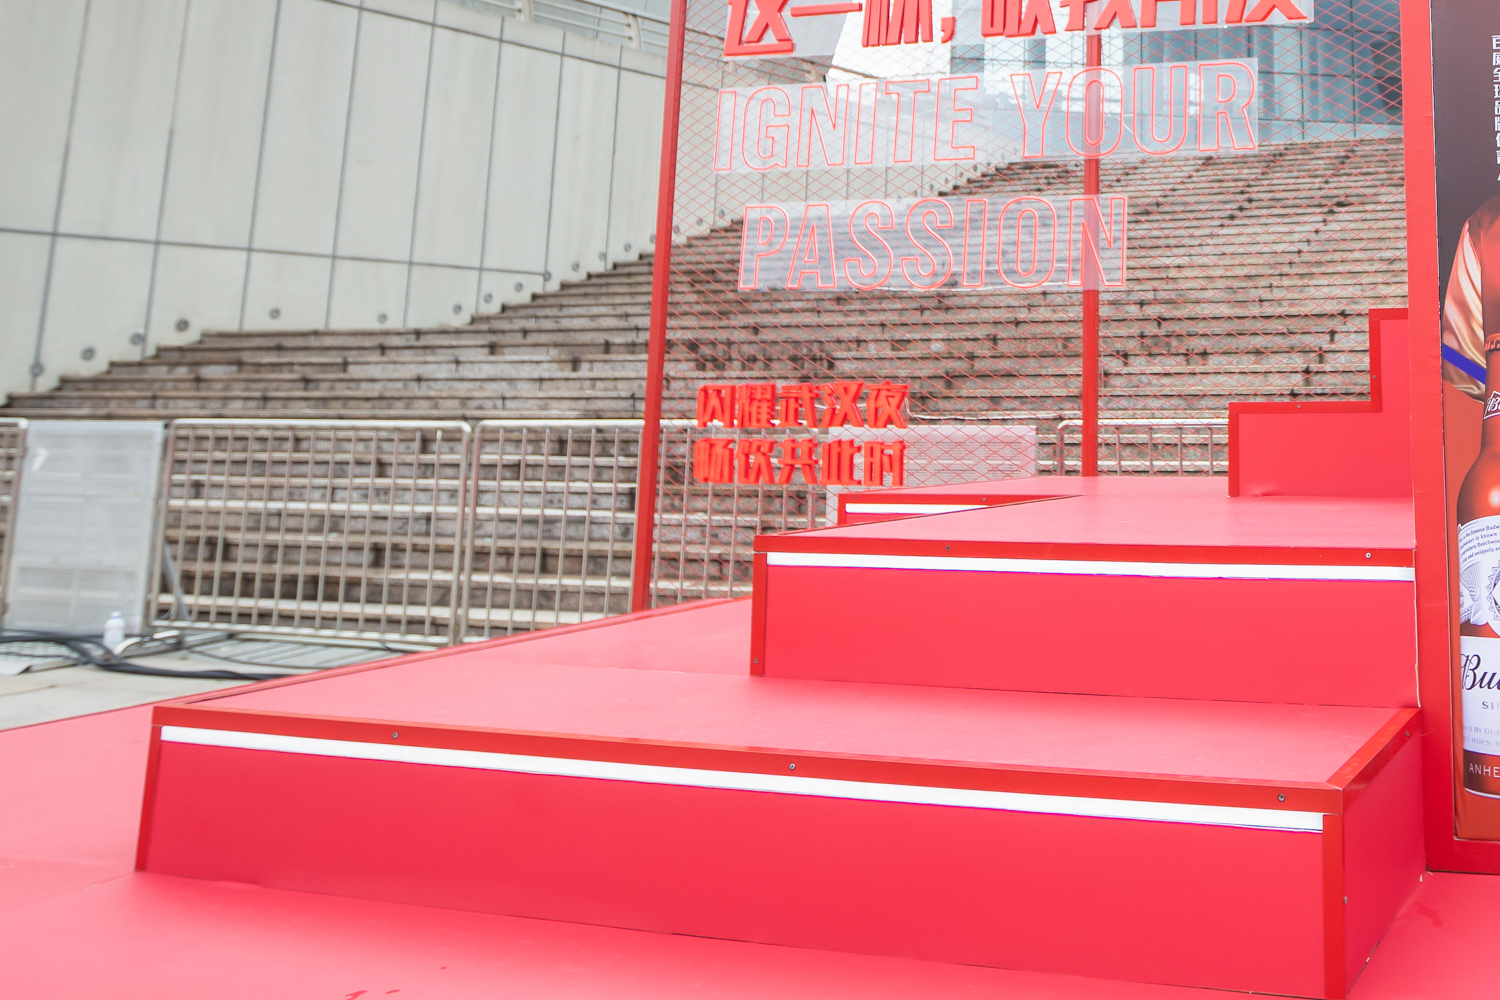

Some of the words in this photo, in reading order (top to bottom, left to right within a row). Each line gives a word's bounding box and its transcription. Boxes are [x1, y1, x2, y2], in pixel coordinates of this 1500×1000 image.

[713, 74, 978, 172] IGNITE
[1010, 61, 1257, 159] YOUR
[740, 195, 1128, 290] PASSION
[696, 380, 910, 429] 闪耀武汉夜
[693, 438, 906, 487] 畅饮共此时
[1475, 547, 1494, 556] uniquely
